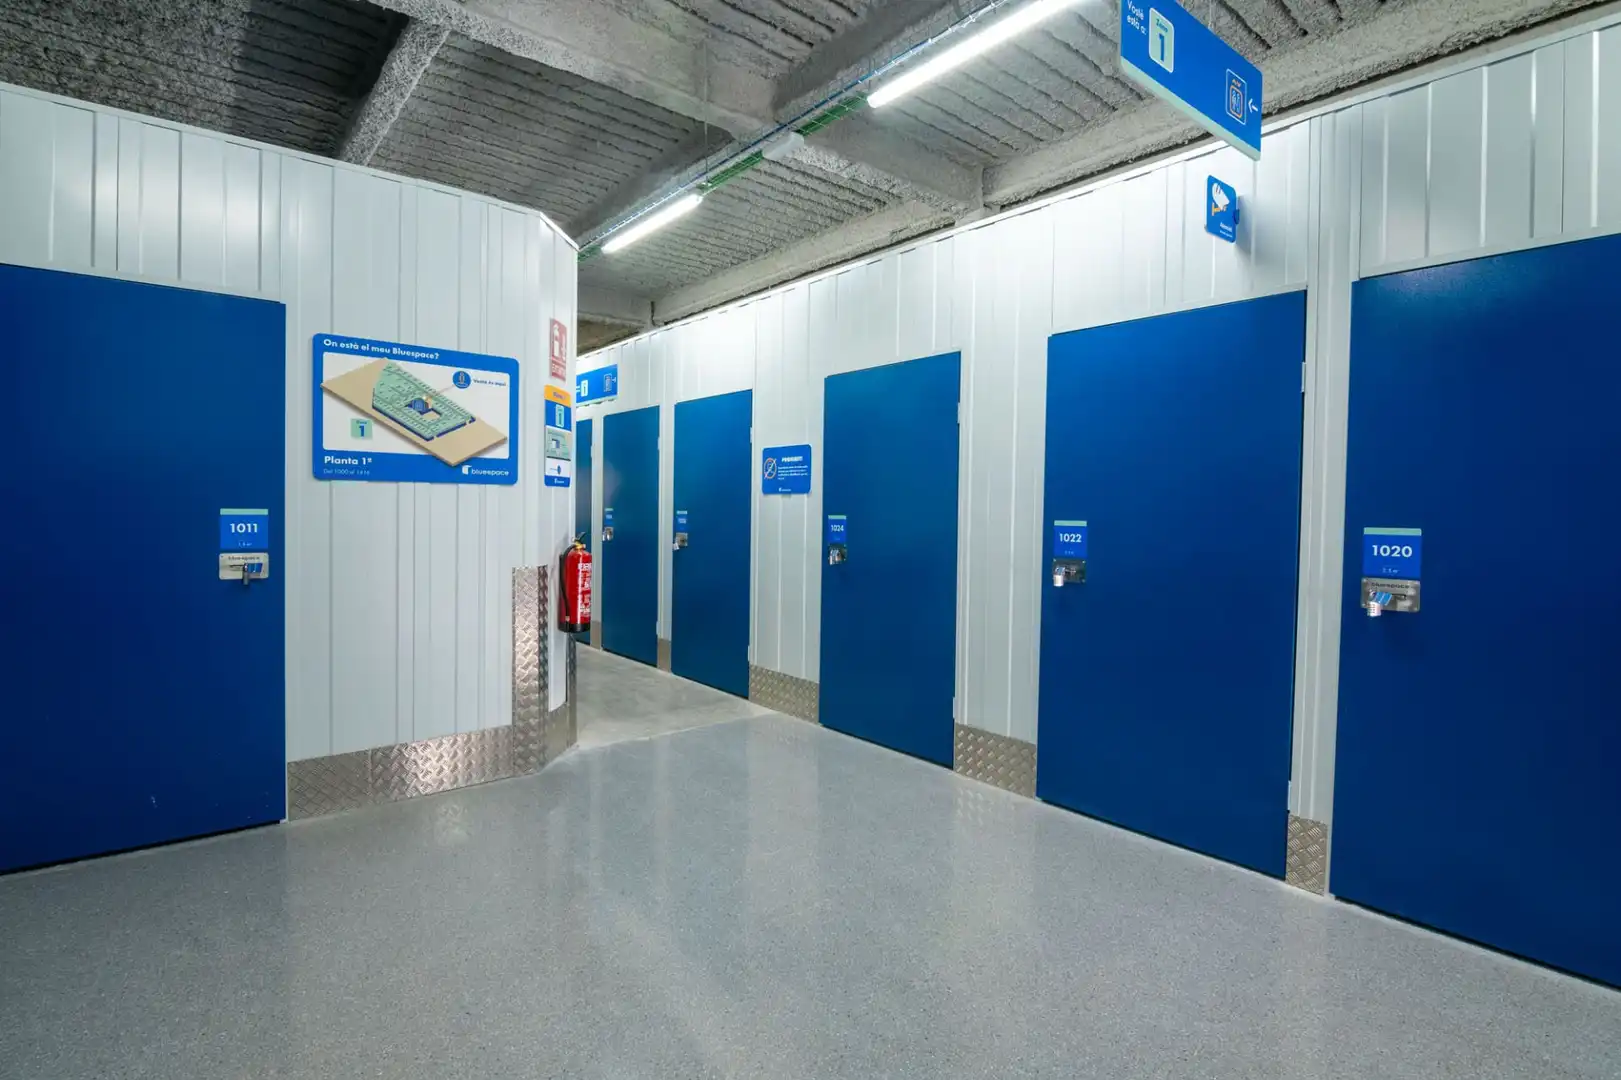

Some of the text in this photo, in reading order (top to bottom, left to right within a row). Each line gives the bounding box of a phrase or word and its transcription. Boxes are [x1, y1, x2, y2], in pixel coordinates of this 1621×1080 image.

[1159, 33, 1165, 62] 1
[323, 338, 338, 347] On
[339, 341, 359, 350] està
[392, 348, 439, 359] Bluespace?
[359, 425, 365, 437] 1
[324, 455, 359, 465] Planta
[229, 523, 258, 533] 1011
[830, 524, 844, 532] 1024
[1059, 532, 1082, 543] 1022
[1372, 545, 1413, 558] 1020
